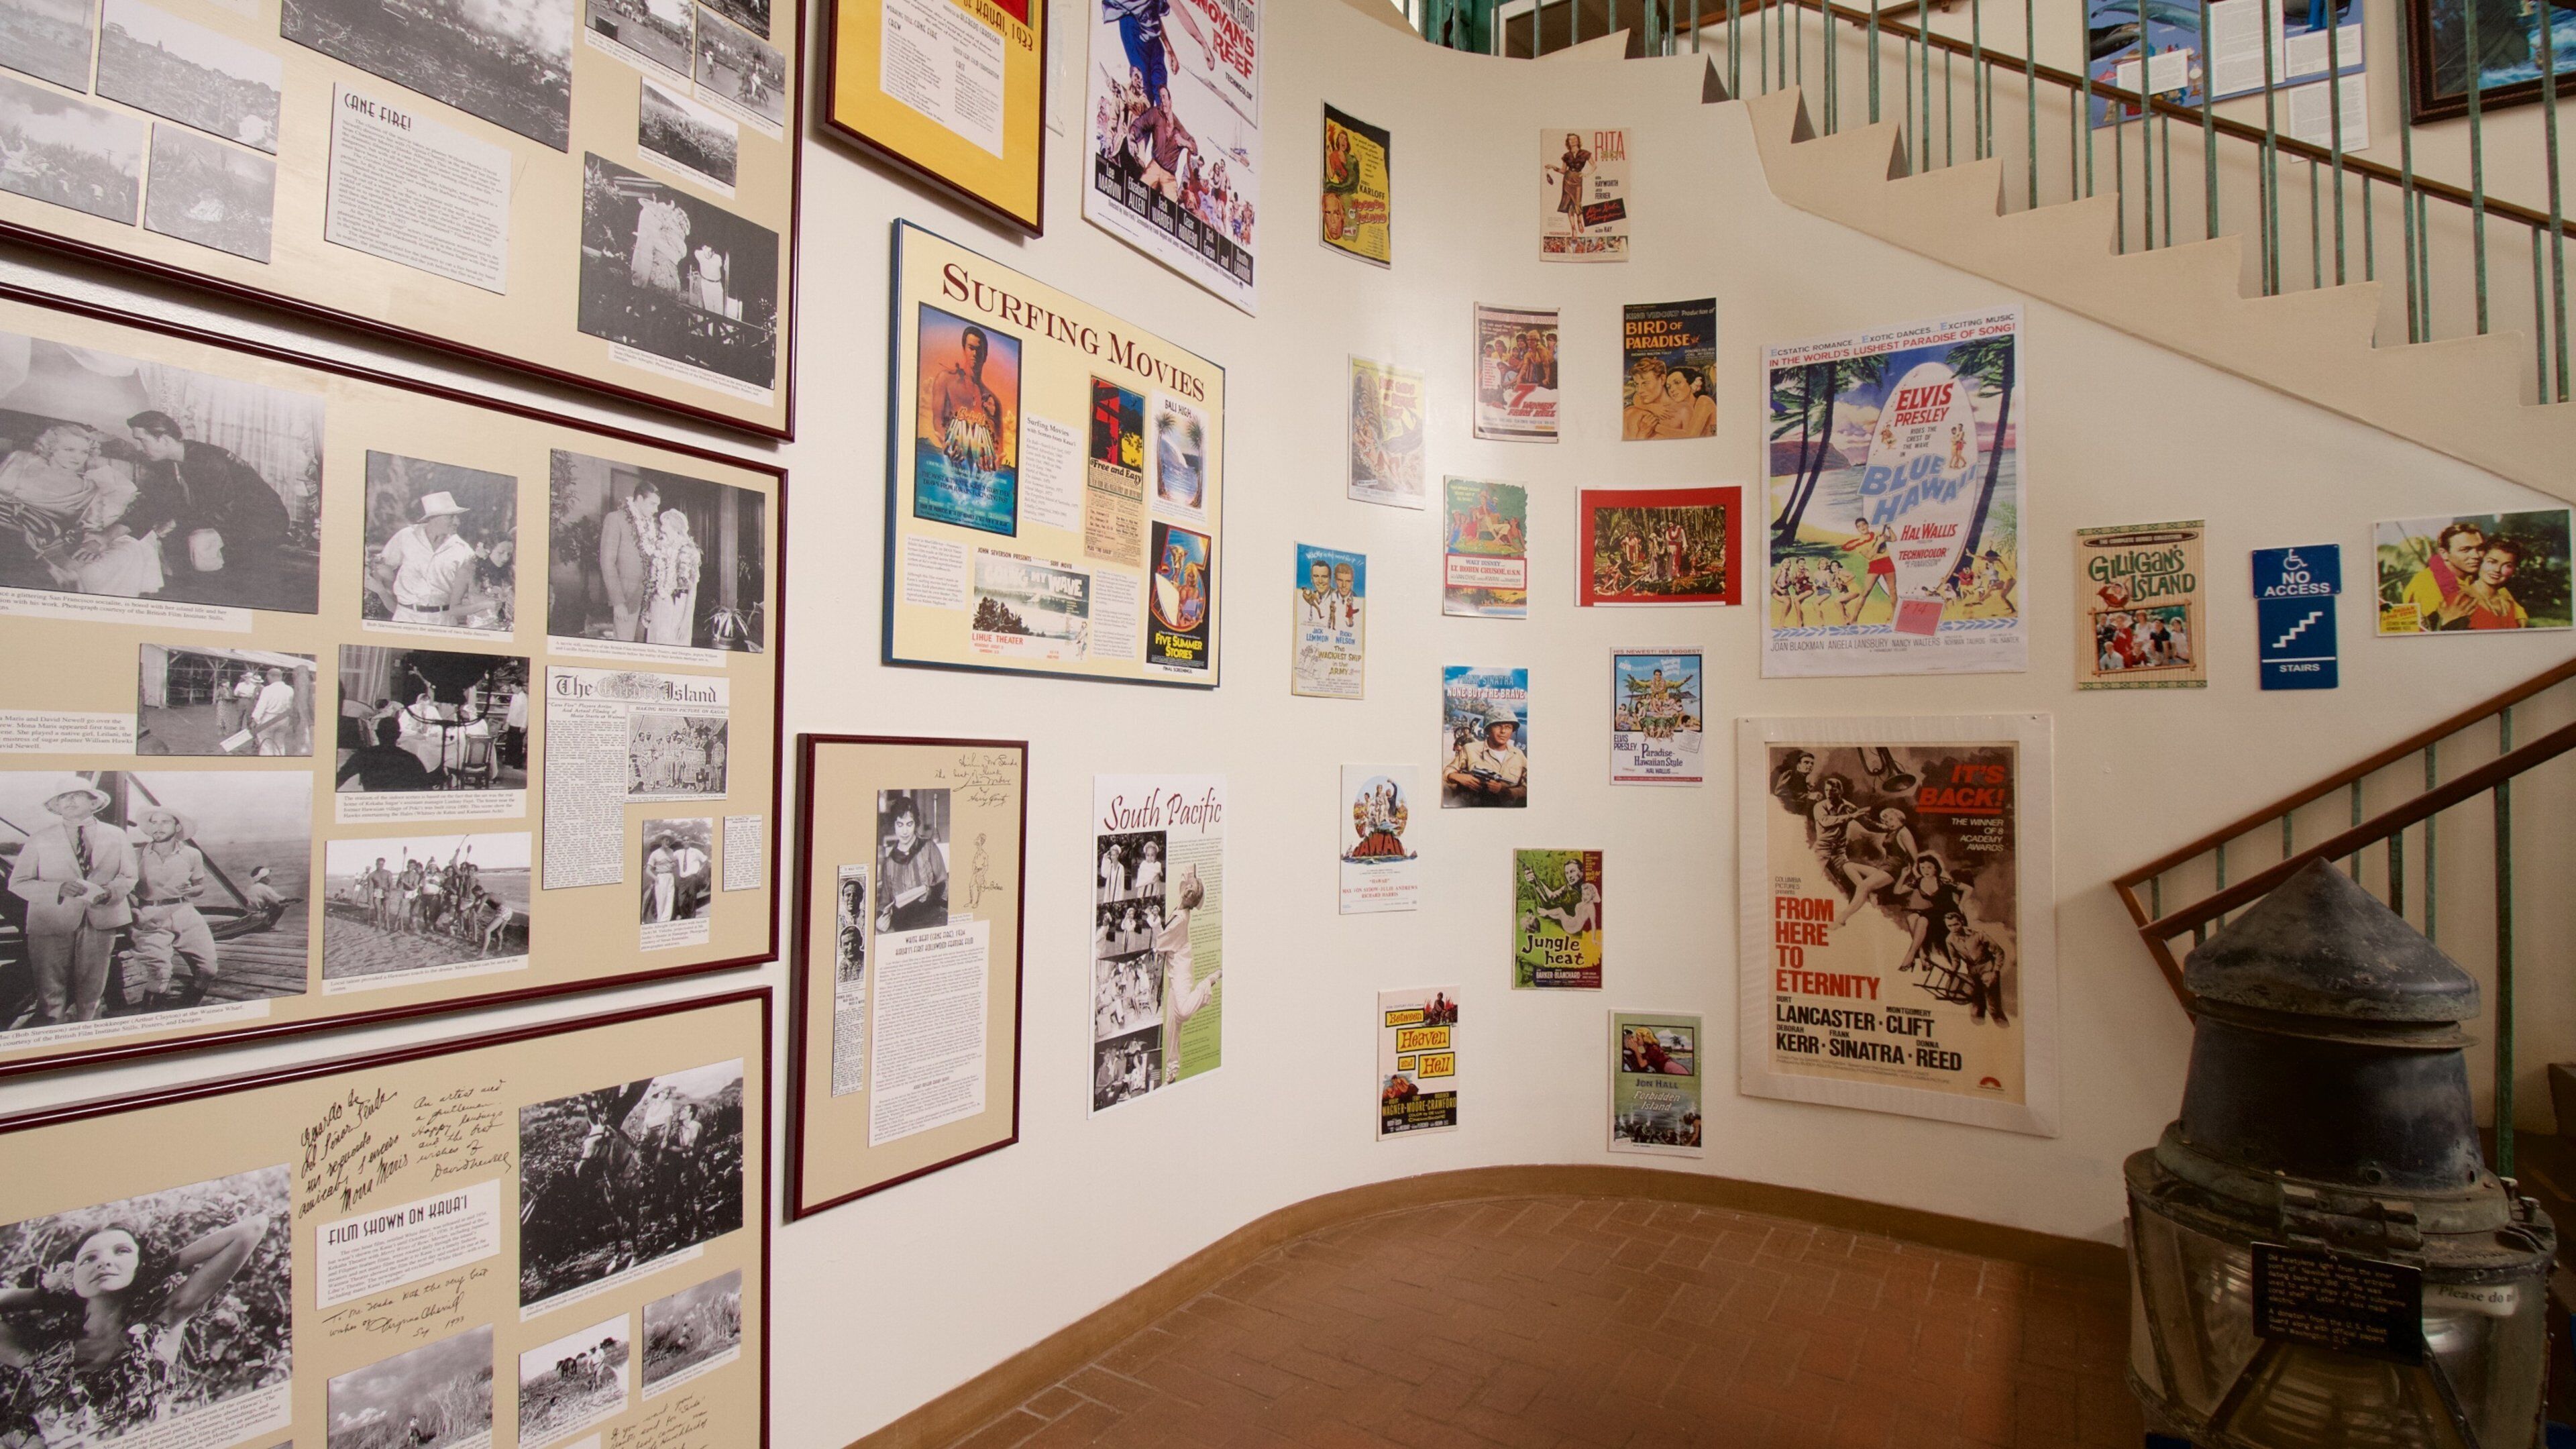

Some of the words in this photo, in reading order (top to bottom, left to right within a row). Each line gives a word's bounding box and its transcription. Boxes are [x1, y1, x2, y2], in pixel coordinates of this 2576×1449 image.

[1238, 0, 1254, 32] FORD
[977, 1, 1008, 36] KAUAI,
[1012, 23, 1033, 51] 1933
[1190, 0, 1254, 58] NOVAN'S
[1213, 28, 1253, 79] REEF
[345, 93, 375, 117] CANE
[380, 107, 411, 131] FIRE!
[1595, 131, 1625, 162] RITA
[1098, 172, 1122, 201] MARVIN
[1128, 177, 1147, 199] Elizabeth
[1359, 184, 1385, 200] KARLOFF
[1128, 195, 1145, 215] ALLEN
[1152, 207, 1173, 233] WARDEN
[1179, 223, 1197, 248] ROMERO
[943, 263, 1100, 356] SURFING
[1108, 331, 1205, 402] MOVIES
[1625, 320, 1667, 335] BIRD
[1670, 322, 1683, 330] OF
[1771, 345, 1810, 357] ECSTATIC
[1862, 333, 1894, 342] EXOTIC
[1940, 318, 1982, 331] EXCITING
[1986, 313, 2014, 325] MUSIC
[1625, 334, 1690, 349] PARADISE
[1770, 359, 1778, 367] IN
[1781, 356, 1800, 365] THE
[1806, 347, 1850, 362] WORLD'S
[1854, 342, 1899, 356] LUSHEST
[1903, 333, 1956, 348] PARADISE
[1960, 329, 1975, 338] OF
[1978, 323, 2015, 335] SONG!
[1510, 384, 1538, 408] 7
[1894, 384, 1954, 411] ELVIS
[1165, 400, 1177, 413] BALI
[1179, 405, 1191, 418] HIGH
[1894, 407, 1949, 427] PRESLEY
[1027, 417, 1049, 431] Surfing
[1049, 425, 1069, 436] Movies
[1111, 467, 1124, 476] and
[1126, 470, 1141, 486] Easy
[1857, 453, 1947, 496] BLUE
[1870, 462, 1978, 526] HAWAII
[1900, 526, 1921, 541] HAL
[1923, 523, 1957, 540] WALLIS
[991, 549, 1011, 558] SEVERSON
[1013, 553, 1031, 561] PRESENTS
[1898, 547, 1946, 560] TECHNICOLOR
[1046, 574, 1082, 597] WAVE
[2282, 572, 2310, 584] NO
[2264, 582, 2330, 596] ACCESS
[62, 603, 98, 611] Photograph
[972, 633, 992, 642] LIHUE
[996, 635, 1023, 645] THEATER
[1155, 633, 1171, 646] FIVE
[1173, 635, 1202, 650] SUMMER
[1306, 633, 1329, 642] LEMMON
[1336, 637, 1355, 645] NELSON
[1771, 641, 1788, 652] JOAN
[1790, 641, 1824, 651] BLACKMAN
[1828, 640, 1853, 649] ANGELA
[1855, 638, 1888, 648] LANSBURY
[1892, 639, 1911, 647] NANCY
[1913, 637, 1940, 647] WALTERS
[1165, 645, 1193, 659] STORIES
[1348, 653, 1362, 661] SHIP
[2279, 663, 2320, 672] STAIRS
[555, 675, 592, 698] The
[663, 681, 717, 702] Island
[1458, 674, 1481, 685] FRANK
[1483, 676, 1513, 686] SINATRA
[1447, 687, 1466, 697] NONE
[1468, 688, 1483, 698] BUT
[1484, 688, 1499, 698] THE
[1501, 688, 1525, 699] BRAVE
[1614, 735, 1628, 743] ELVIS
[1634, 756, 1665, 766] Hawaiian
[1666, 757, 1682, 767] Style
[1951, 765, 2004, 784] IT'S
[1919, 788, 2004, 806] BACK!
[1104, 788, 1160, 831] South
[1167, 787, 1222, 833] Pacific
[1352, 831, 1404, 857] HAWAII
[1960, 835, 2002, 843] ACADEMY
[1967, 843, 2004, 851] AWARDS
[1775, 897, 1834, 922] FROM
[1775, 921, 1829, 947] HERE
[1521, 934, 1580, 954] Jungle
[1545, 951, 1585, 965] heat
[1776, 945, 1803, 969] TO
[1536, 971, 1553, 979] BARKER
[1776, 969, 1880, 1000] ETERNITY
[1389, 1012, 1421, 1024] Between
[1776, 1004, 1876, 1032] LANCASTER
[1886, 1015, 1935, 1038] CLIFT
[1886, 1006, 1931, 1017] MONTGOMERY
[1400, 1030, 1446, 1049] Heaven
[1776, 1024, 1804, 1034] DEBORAH
[1829, 1030, 1849, 1038] FRANK
[1917, 1040, 1939, 1049] DONNA
[1776, 1032, 1819, 1054] KERR
[1829, 1038, 1904, 1065] SINATRA
[1917, 1051, 1962, 1071] REED
[1423, 1057, 1450, 1074] Hell
[1635, 1078, 1652, 1087] JON
[1656, 1080, 1678, 1088] HALL
[1633, 1091, 1680, 1102] Forbidden
[1382, 1103, 1404, 1116] WAGNER
[1407, 1099, 1425, 1112] MOORE
[1428, 1097, 1456, 1110] CRAWFORD
[1642, 1102, 1672, 1111] Island
[328, 1223, 358, 1246] FILM
[364, 1212, 403, 1236] SHOWN
[409, 1208, 424, 1225] ON
[429, 1195, 468, 1221] KAUA'I
[2438, 1286, 2484, 1301] Please
[2489, 1292, 2504, 1302] do
